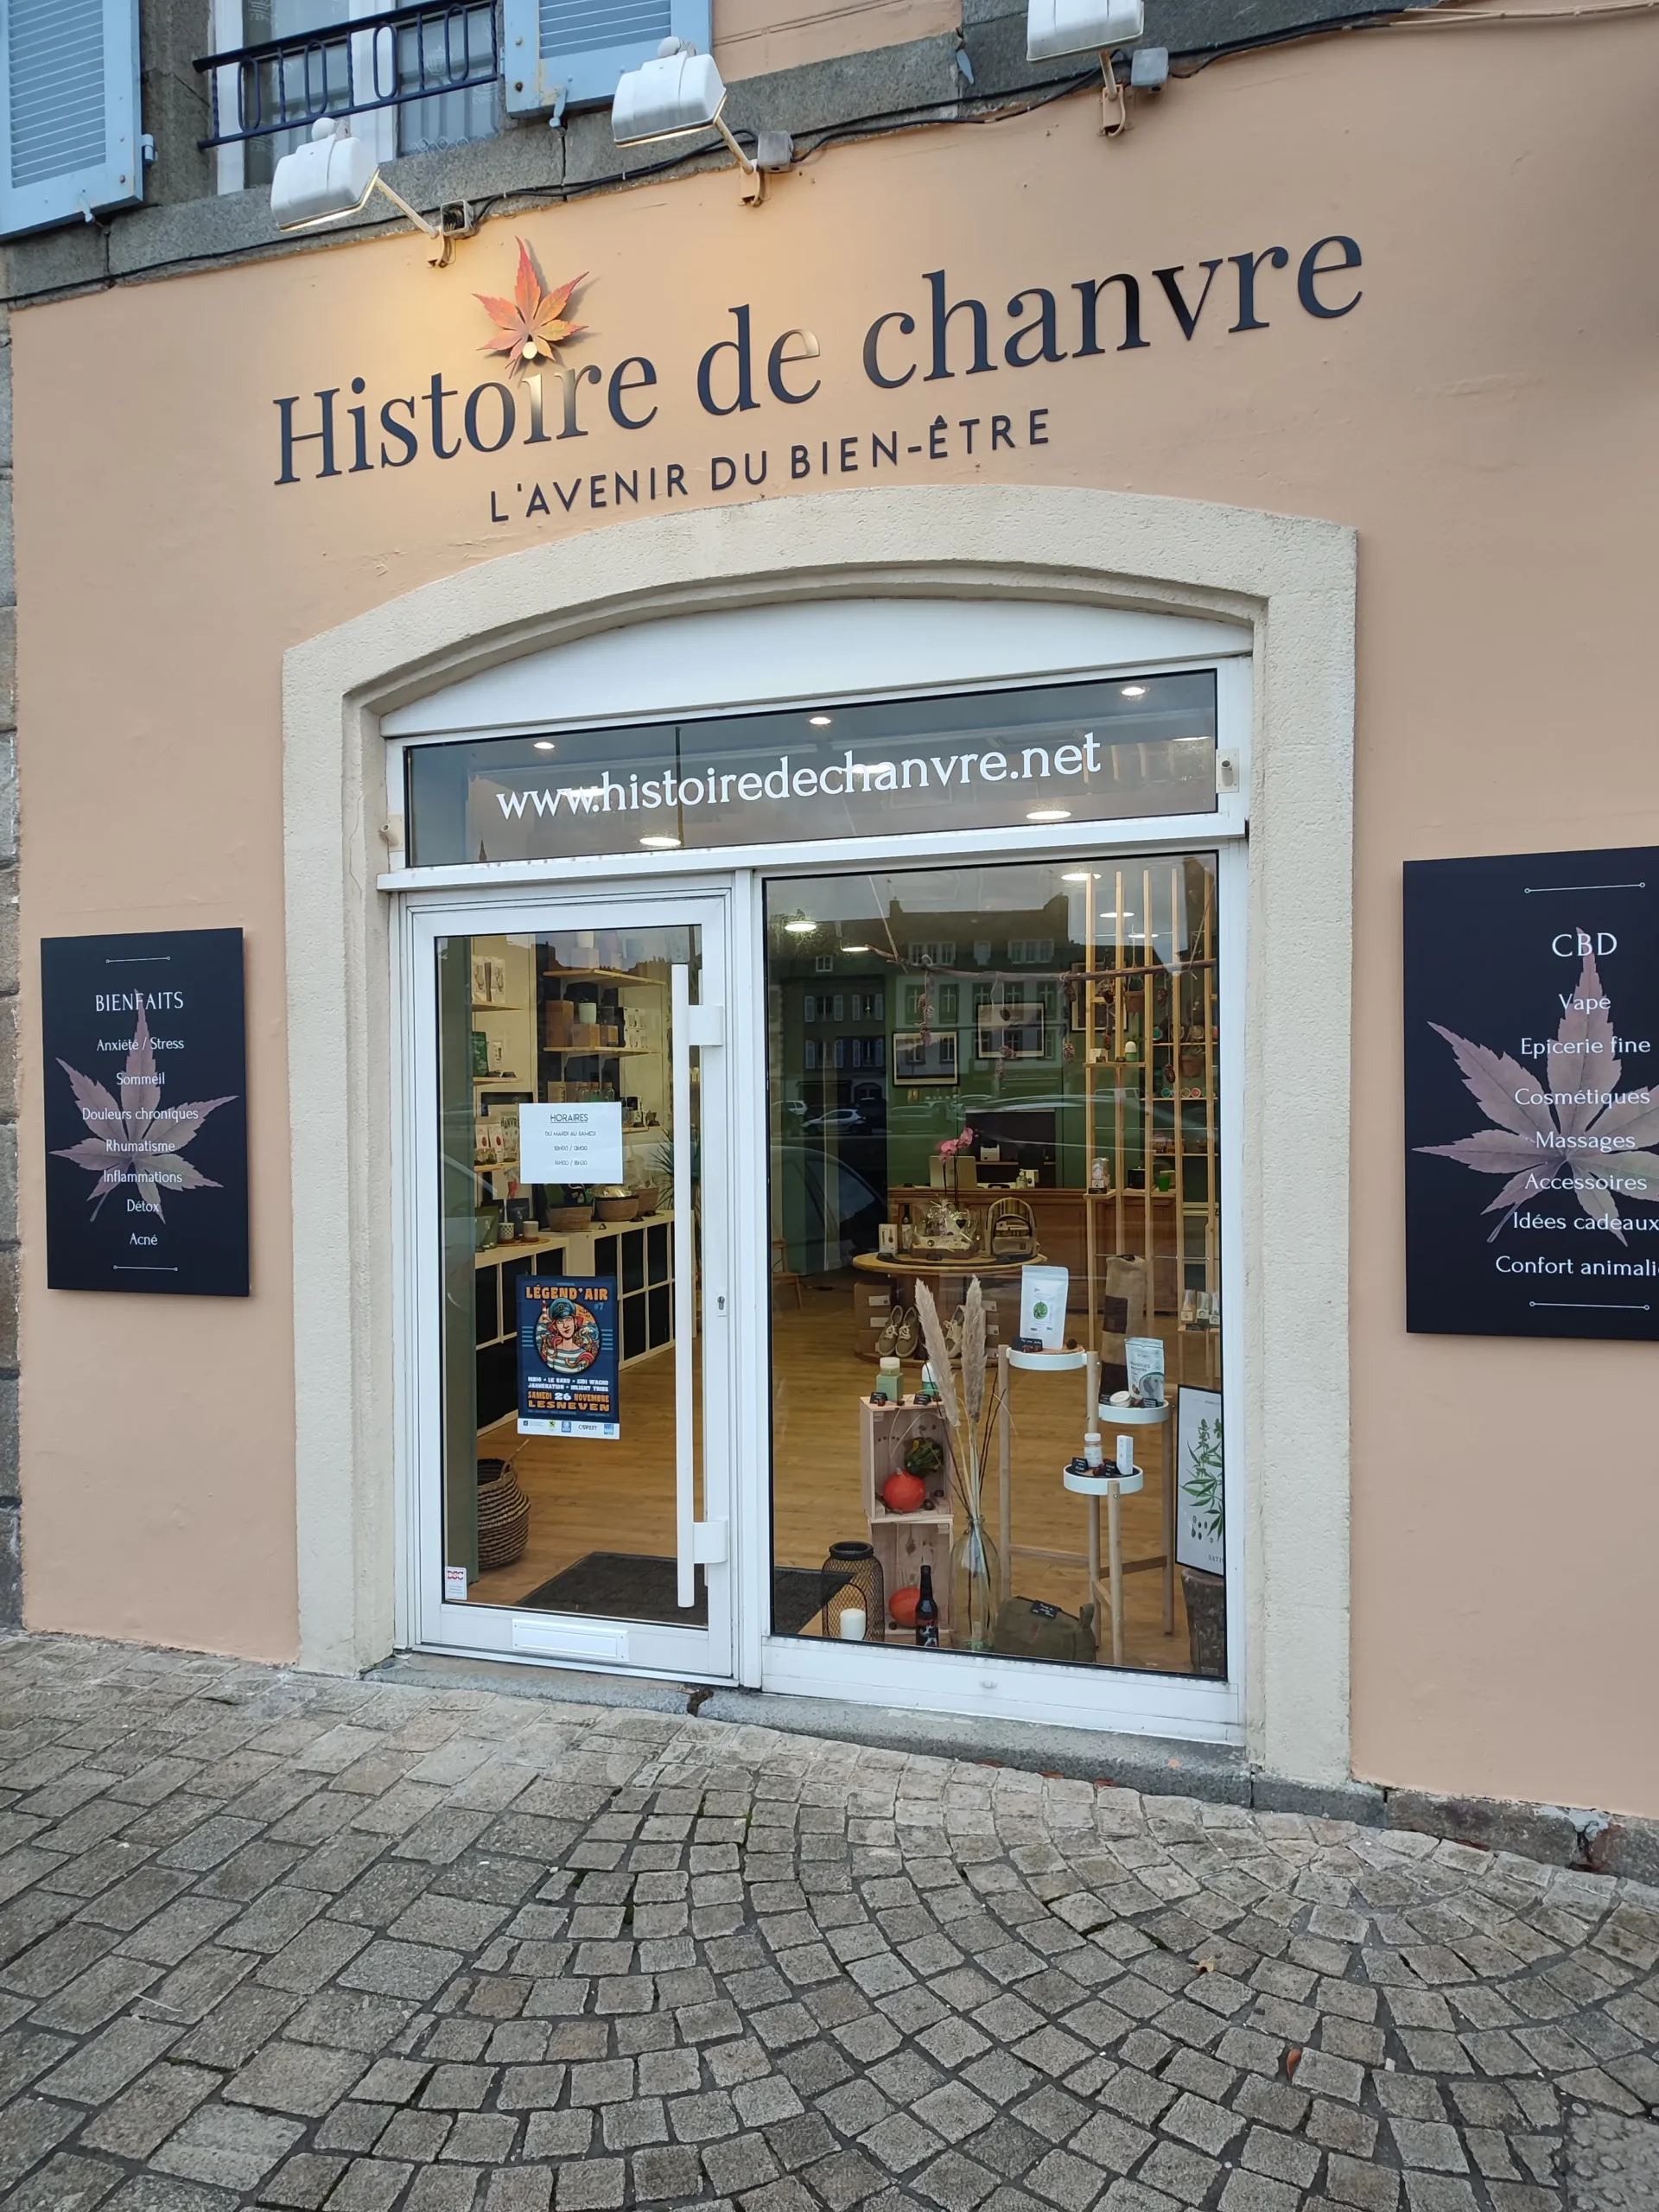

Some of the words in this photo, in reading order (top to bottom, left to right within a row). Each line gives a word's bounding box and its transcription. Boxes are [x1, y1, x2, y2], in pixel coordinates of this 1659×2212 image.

[273, 356, 658, 485] Histoire
[696, 303, 821, 416] de
[862, 235, 1363, 388] chanvre
[490, 463, 689, 522] L'AVENIR
[711, 450, 767, 491] DU
[791, 408, 1049, 479] BIEN-ÊTRE
[496, 732, 1101, 820] www.histoiredechanvre.net
[1551, 932, 1618, 957] CBD
[95, 991, 184, 1012] BIENFAITS
[1558, 993, 1611, 1015] Vape
[96, 1039, 139, 1052] Anxiété
[142, 1037, 148, 1051] /
[149, 1036, 185, 1050] Stress
[1521, 1037, 1604, 1059] Epicerie
[1610, 1035, 1651, 1053] fine
[116, 1071, 165, 1085] Sommeil
[1514, 1087, 1650, 1109] Cosmétiques
[82, 1107, 132, 1121] Douleurs
[135, 1107, 199, 1122] chroniques
[550, 1113, 588, 1122] HORAIRES
[105, 1139, 175, 1153] Rhumatisme
[1535, 1130, 1636, 1154] Massages
[104, 1169, 183, 1183] Inflammations
[1524, 1173, 1648, 1191] Accessoires
[126, 1198, 160, 1212] Détox
[1513, 1211, 1567, 1230] Idées
[1573, 1212, 1659, 1231] cadeaux
[130, 1232, 158, 1246] Acné
[1496, 1255, 1574, 1274] Confort
[1580, 1258, 1659, 1276] animali
[527, 1391, 552, 1400] SAMEDI
[554, 1392, 572, 1401] 26
[574, 1393, 609, 1403] NOVEMBRE
[528, 1400, 610, 1412] LESNEVEN
